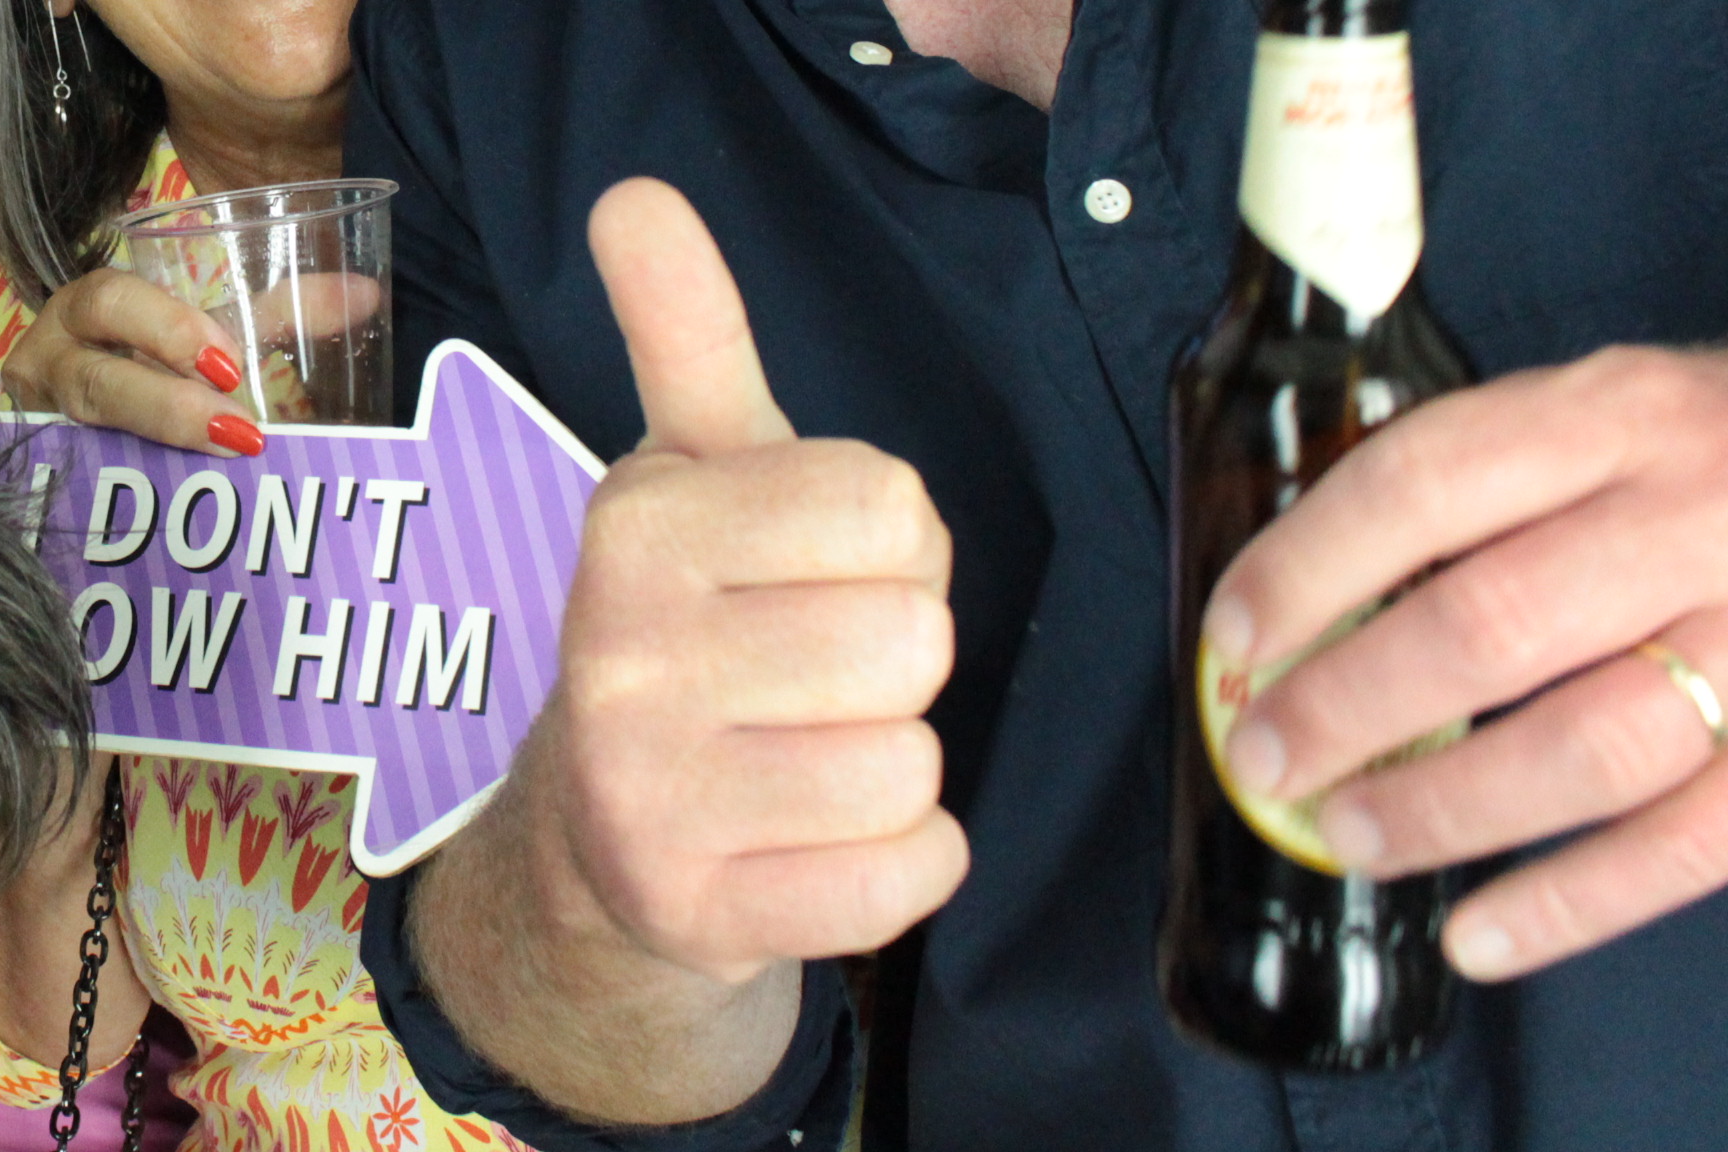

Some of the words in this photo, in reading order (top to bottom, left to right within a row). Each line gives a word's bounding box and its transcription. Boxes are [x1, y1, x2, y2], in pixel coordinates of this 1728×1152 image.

[22, 463, 56, 556] I
[83, 466, 430, 583] DON'T
[272, 595, 495, 715] HIM
